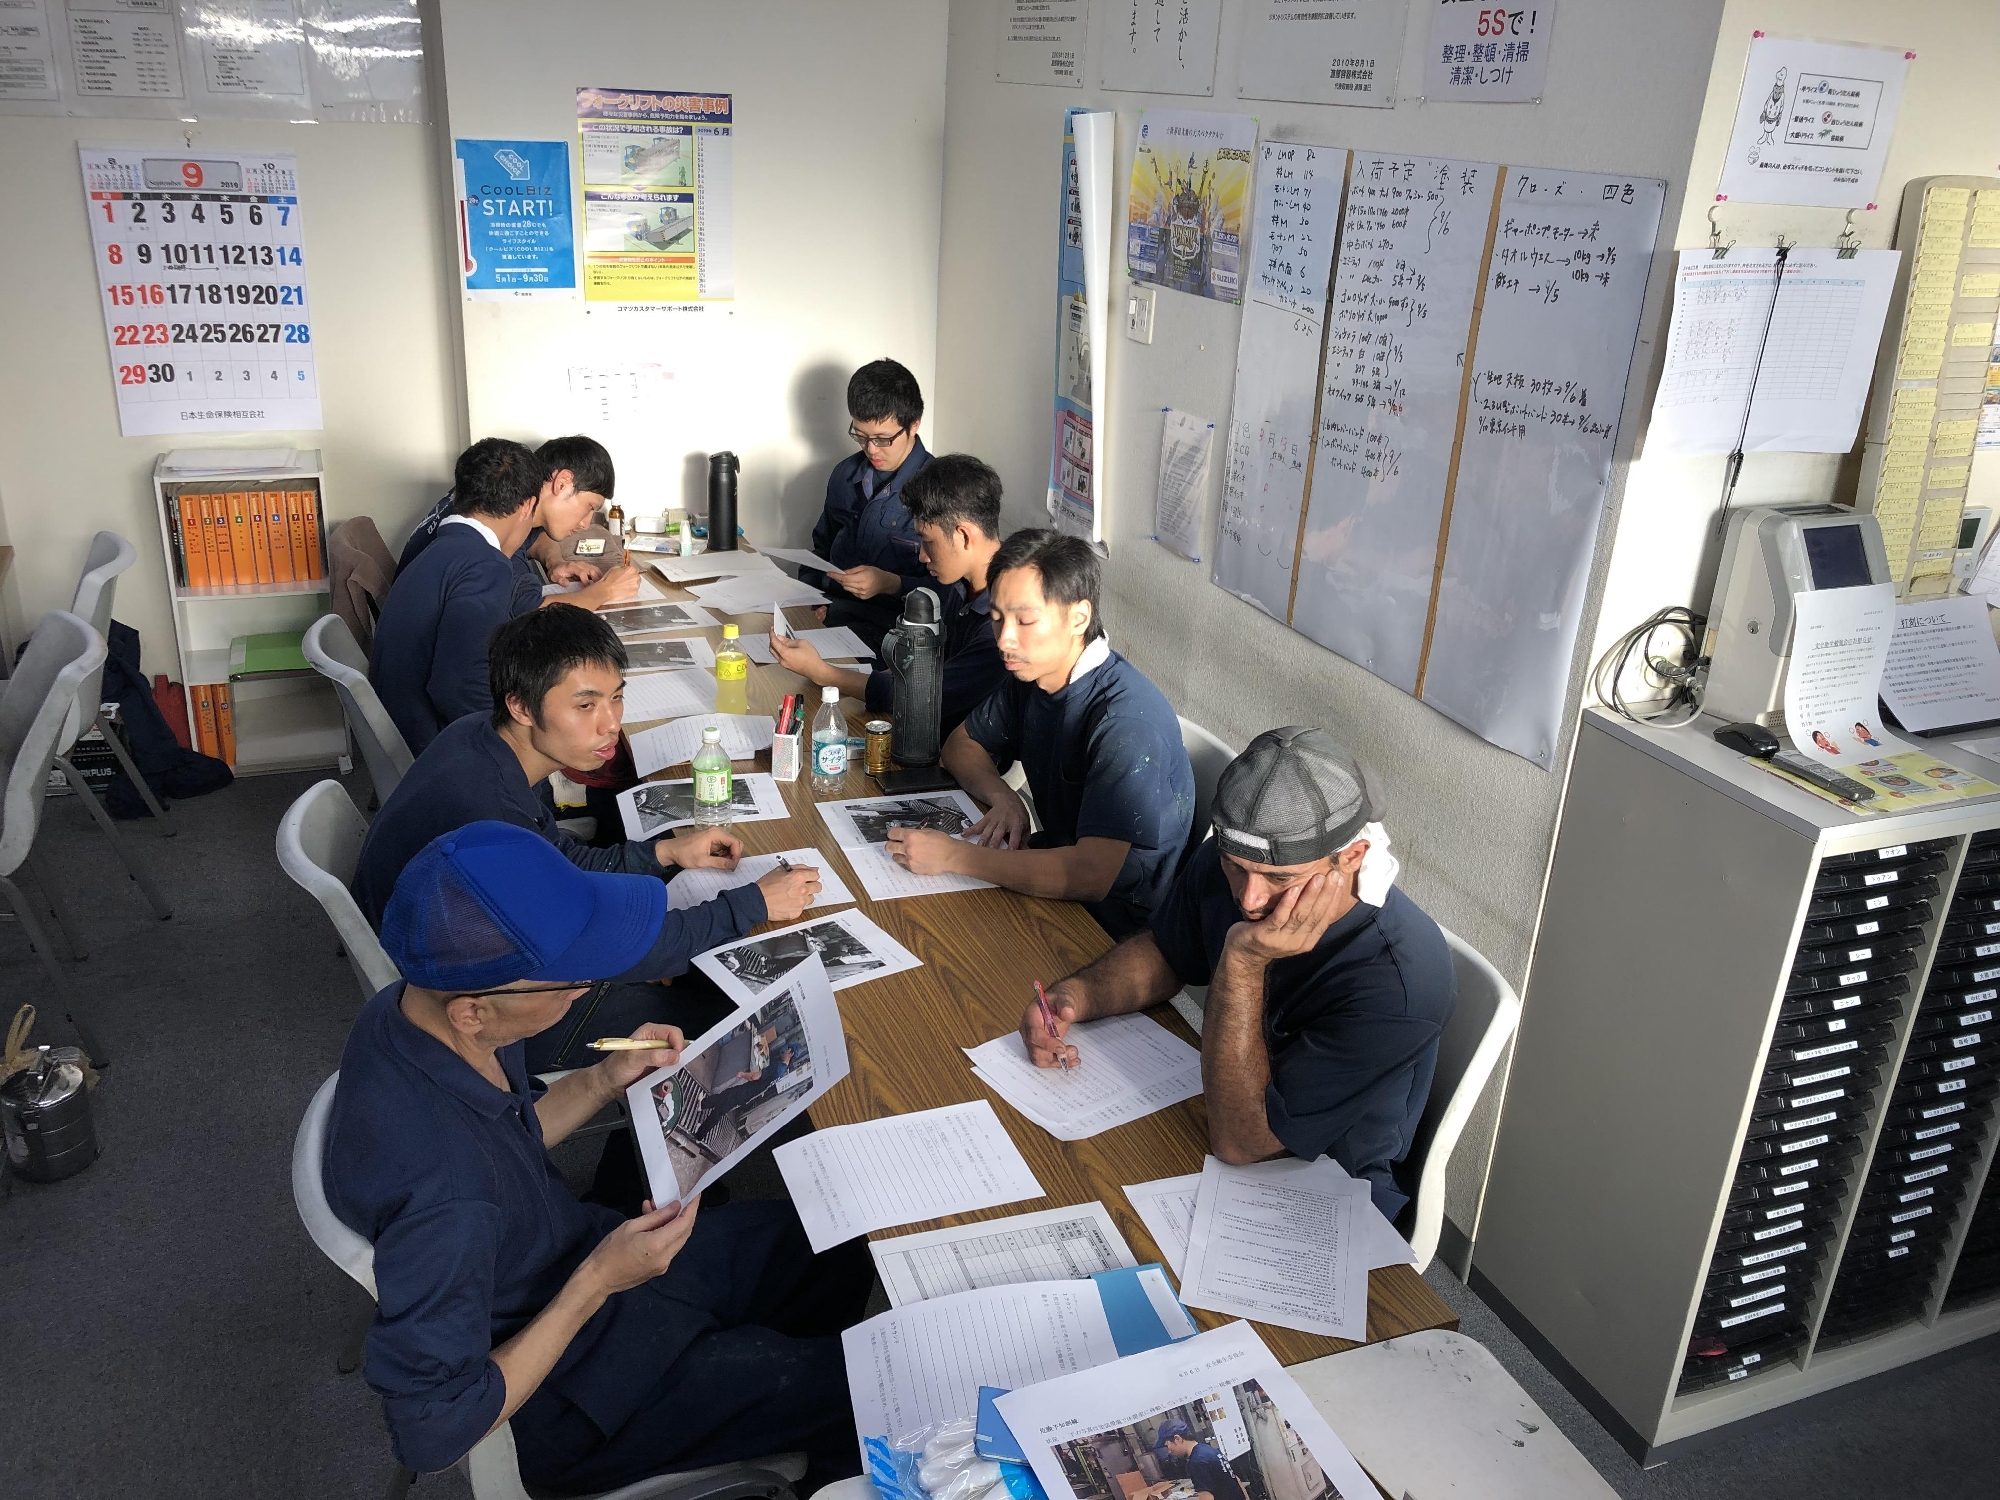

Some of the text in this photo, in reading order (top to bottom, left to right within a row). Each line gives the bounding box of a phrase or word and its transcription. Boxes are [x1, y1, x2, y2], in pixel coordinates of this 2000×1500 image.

[1331, 58, 1376, 68] 2010年8月1日
[1441, 41, 1530, 64] 整理・整頓・清掃
[1449, 66, 1514, 86] 清潔・しつけ
[578, 91, 730, 115] フォークリフトの災害事例
[499, 155, 521, 177] CHOICE
[508, 154, 525, 171] COOL
[1356, 158, 1416, 182] 入荷予定
[181, 162, 204, 189] 9
[101, 202, 291, 227] 1 2 3 4 5 6 7
[482, 199, 553, 217] START!
[108, 243, 303, 266] 8 9 10 11 12 13 14
[107, 283, 304, 306] 15 16 17 18 19 20 21
[616, 305, 705, 313] コマツカスタマーサポート株式会社
[113, 323, 311, 346] 22 23 24 25 26 27 28
[119, 363, 306, 385] 29 30 1 2 3 4 5
[180, 410, 266, 421] 日本生命保険相互会社
